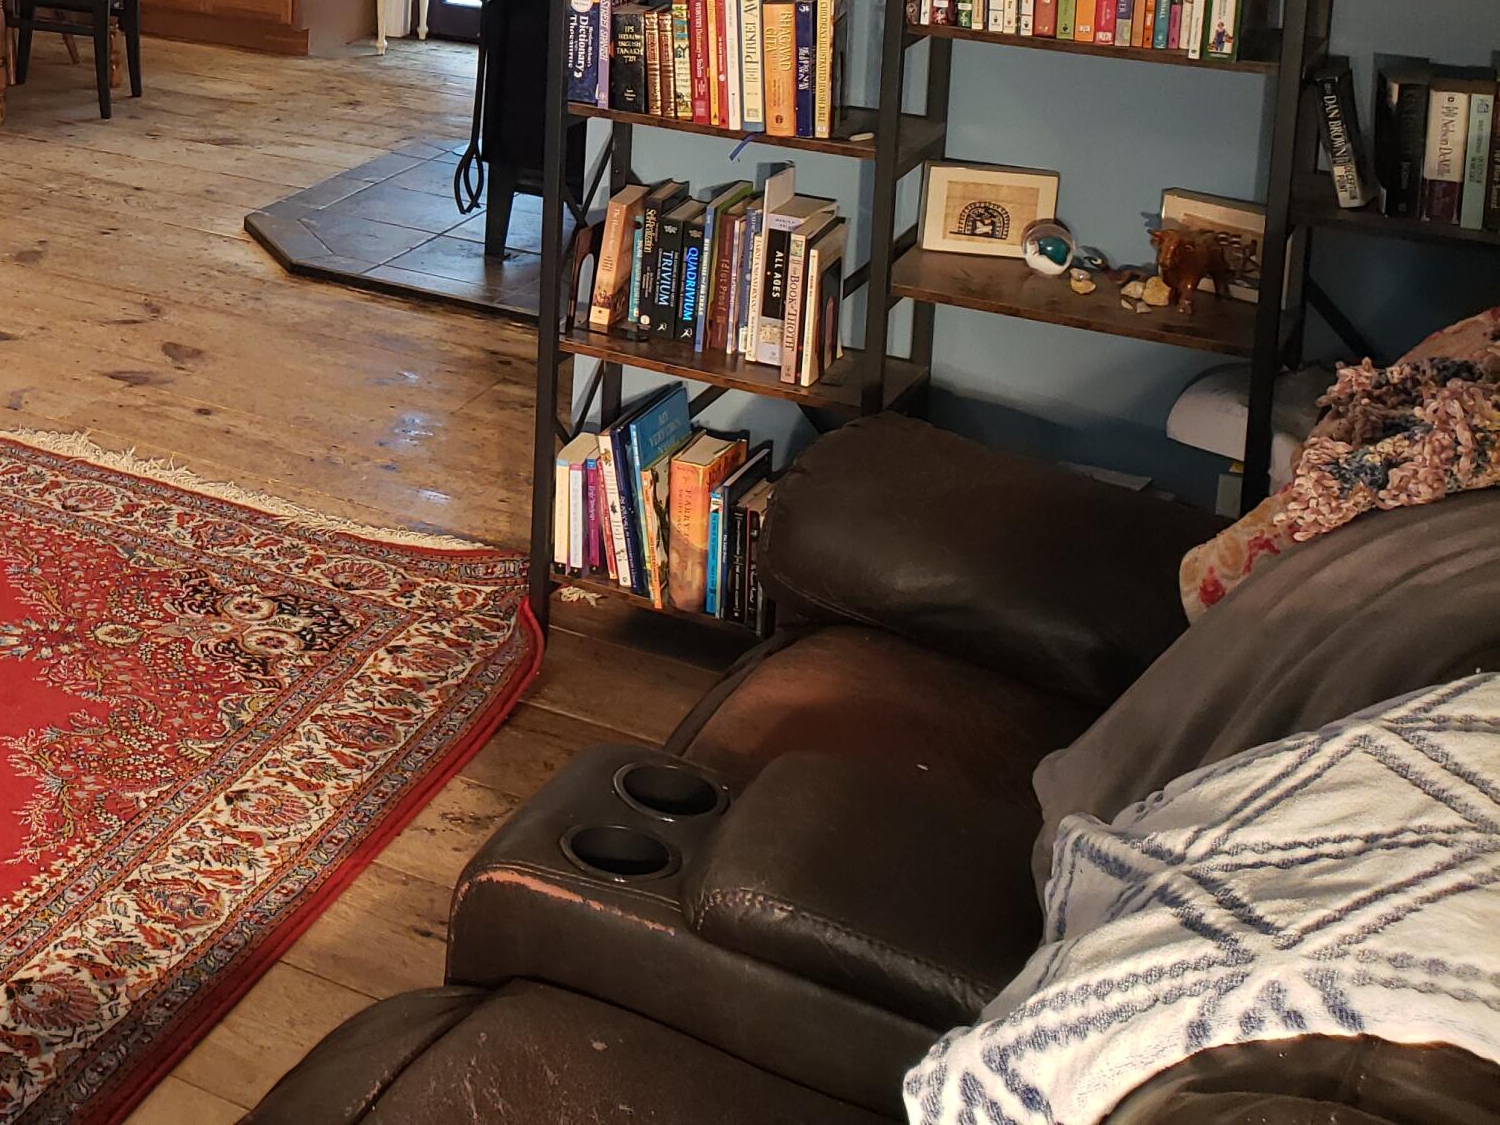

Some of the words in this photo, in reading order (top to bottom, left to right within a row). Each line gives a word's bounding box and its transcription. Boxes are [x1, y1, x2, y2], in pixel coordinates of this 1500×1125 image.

[601, 0, 610, 29] STREET
[819, 2, 828, 39] CHILDREN'S
[576, 16, 587, 69] Dictionary
[599, 30, 609, 61] SPANISH
[744, 22, 759, 64] PIRKEI
[765, 27, 775, 53] GITA
[778, 11, 792, 71] BHAGAVAD
[818, 40, 827, 81] ILLUSTRATED
[818, 83, 826, 105] JEWISH
[1323, 95, 1339, 118] DAN
[1328, 121, 1348, 156] BROWN
[1440, 119, 1455, 146] Nelson
[1336, 175, 1347, 193] POINT
[1344, 166, 1359, 200] DECEPTION
[719, 259, 730, 283] Idiot
[772, 251, 784, 269] ALL
[658, 251, 674, 306] TRIVIUM
[683, 247, 699, 321] QUADRIVIUM
[771, 271, 782, 298] AGES
[788, 275, 799, 304] BOOK
[717, 285, 727, 311] Proof
[785, 310, 797, 352] THOTH
[683, 490, 692, 531] HARRY
